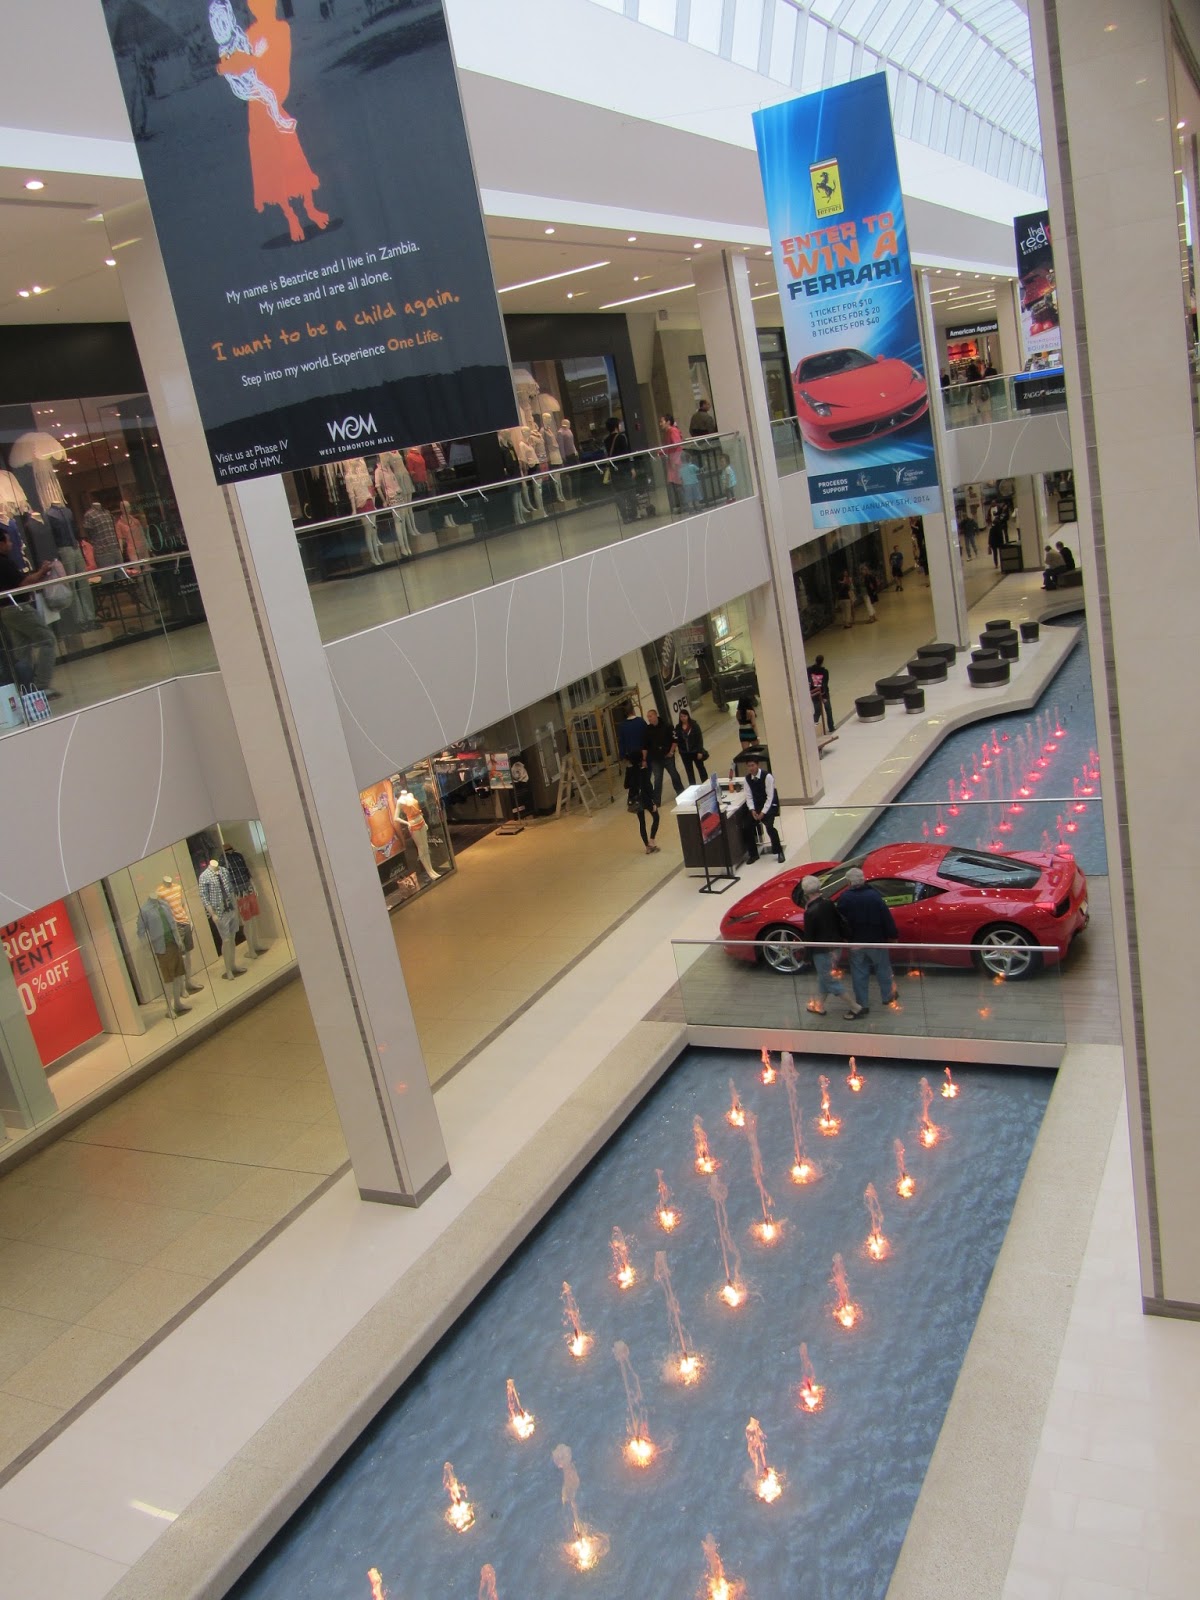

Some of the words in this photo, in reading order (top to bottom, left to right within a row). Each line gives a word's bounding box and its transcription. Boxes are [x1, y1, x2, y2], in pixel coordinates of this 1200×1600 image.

[817, 204, 842, 215] Ferrari
[780, 221, 856, 255] ENTER
[862, 211, 894, 233] TO
[1020, 222, 1047, 251] red
[783, 239, 860, 280] WIN
[872, 229, 898, 259] A
[225, 291, 241, 304] My
[243, 284, 268, 299] name
[270, 280, 278, 291] is
[279, 270, 319, 288] Beatrice
[321, 260, 339, 277] and
[340, 259, 346, 271] I
[347, 257, 364, 269] live
[365, 252, 377, 264] in
[378, 241, 420, 261] Zambia.
[787, 257, 900, 301] FERRARI
[259, 301, 274, 315] My
[276, 296, 301, 310] niece
[303, 287, 321, 302] and
[322, 285, 327, 297] I
[329, 284, 345, 296] are
[347, 276, 359, 291] all
[361, 271, 392, 287] alone.
[815, 306, 840, 317] TICKET
[842, 301, 857, 311] FOR
[859, 298, 873, 307] $10
[817, 314, 847, 327] TICKETS
[848, 310, 863, 319] FOR
[211, 342, 227, 361] I
[232, 333, 272, 357] want
[279, 329, 300, 345] to
[306, 321, 328, 337] be
[335, 320, 347, 331] a
[354, 302, 396, 325] child
[404, 289, 460, 317] again.
[818, 324, 848, 336] TICKETS
[850, 320, 864, 329] FOR
[866, 316, 880, 326] $40
[950, 328, 976, 337] American
[976, 323, 998, 333] Apparel
[241, 375, 262, 387] Step
[263, 369, 282, 382] into
[284, 366, 298, 378] my
[300, 355, 332, 372] world.
[332, 344, 386, 366] Experience
[387, 338, 414, 351] One
[416, 330, 443, 345] Life.
[215, 453, 234, 464] Visit
[235, 452, 244, 460] us
[245, 449, 254, 459] at
[254, 443, 278, 456] Phase
[279, 440, 288, 450] IV
[319, 447, 336, 456] WEST
[338, 440, 375, 453] EDMONTON
[377, 436, 395, 445] MALL
[219, 467, 228, 477] in
[228, 463, 249, 475] front
[249, 460, 258, 470] of
[259, 455, 283, 468] HMV.
[818, 479, 848, 488] PROCEEDS
[822, 485, 849, 495] SUPPORT
[820, 507, 841, 516] DRAW
[842, 504, 860, 513] DATE
[861, 500, 894, 511] JANUARY
[46, 960, 70, 986] OFF
